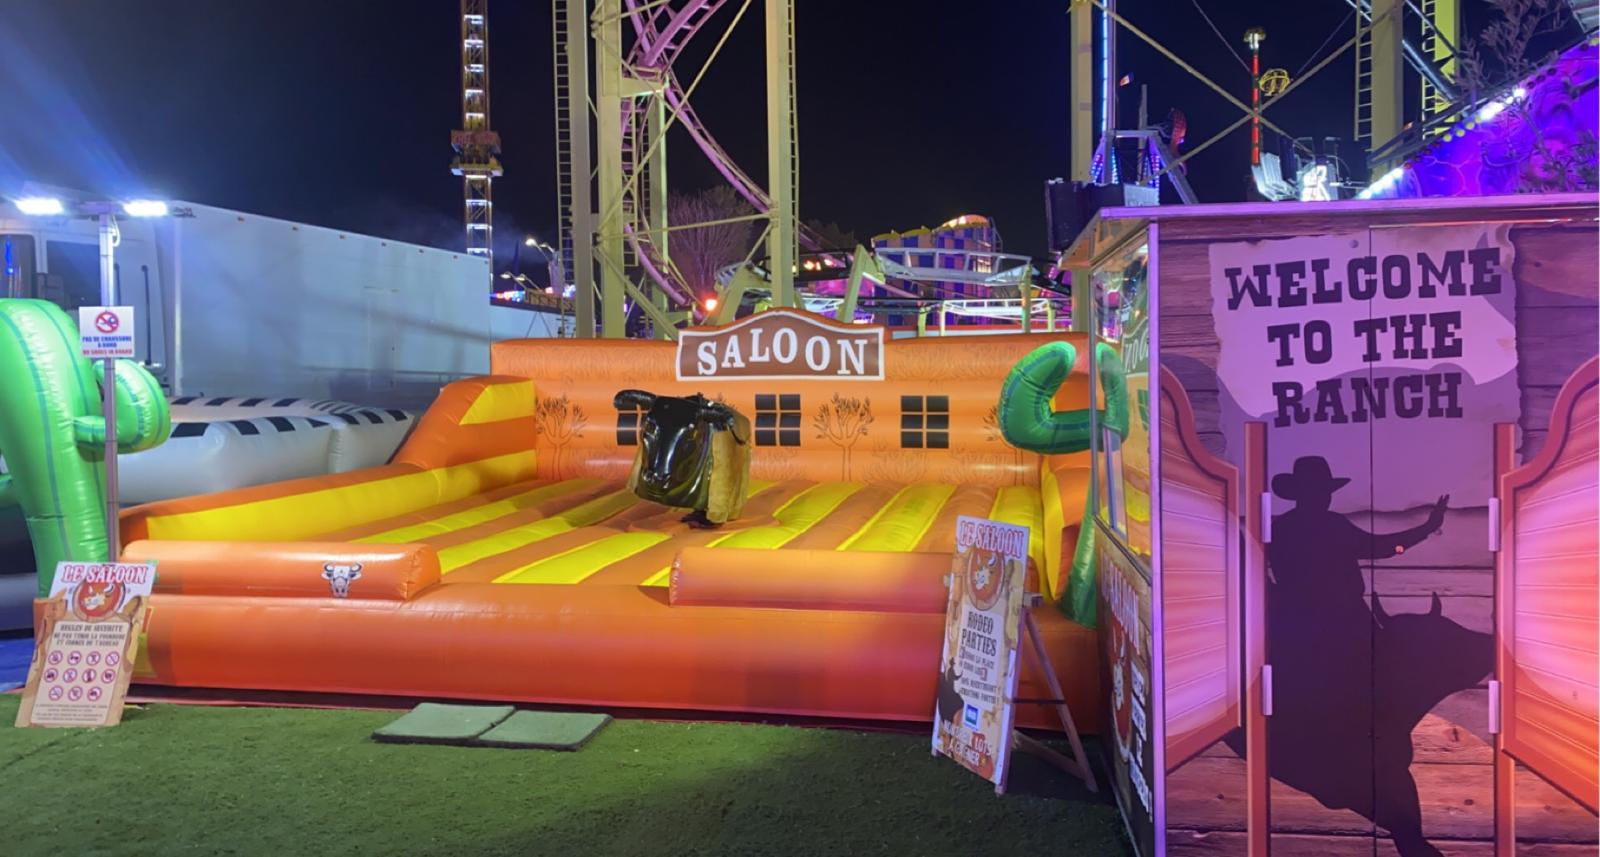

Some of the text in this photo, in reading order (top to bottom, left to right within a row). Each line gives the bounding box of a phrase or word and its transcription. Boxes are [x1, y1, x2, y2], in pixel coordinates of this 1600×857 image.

[1224, 247, 1502, 311] WELCOME
[697, 327, 868, 375] SALOON
[1267, 310, 1463, 367] TO THE
[1272, 372, 1463, 428] RANCH
[960, 520, 1024, 559] LE SALOON
[62, 564, 148, 584] LE SALOON
[961, 628, 997, 657] PARTIES
[967, 611, 994, 635] RODEO
